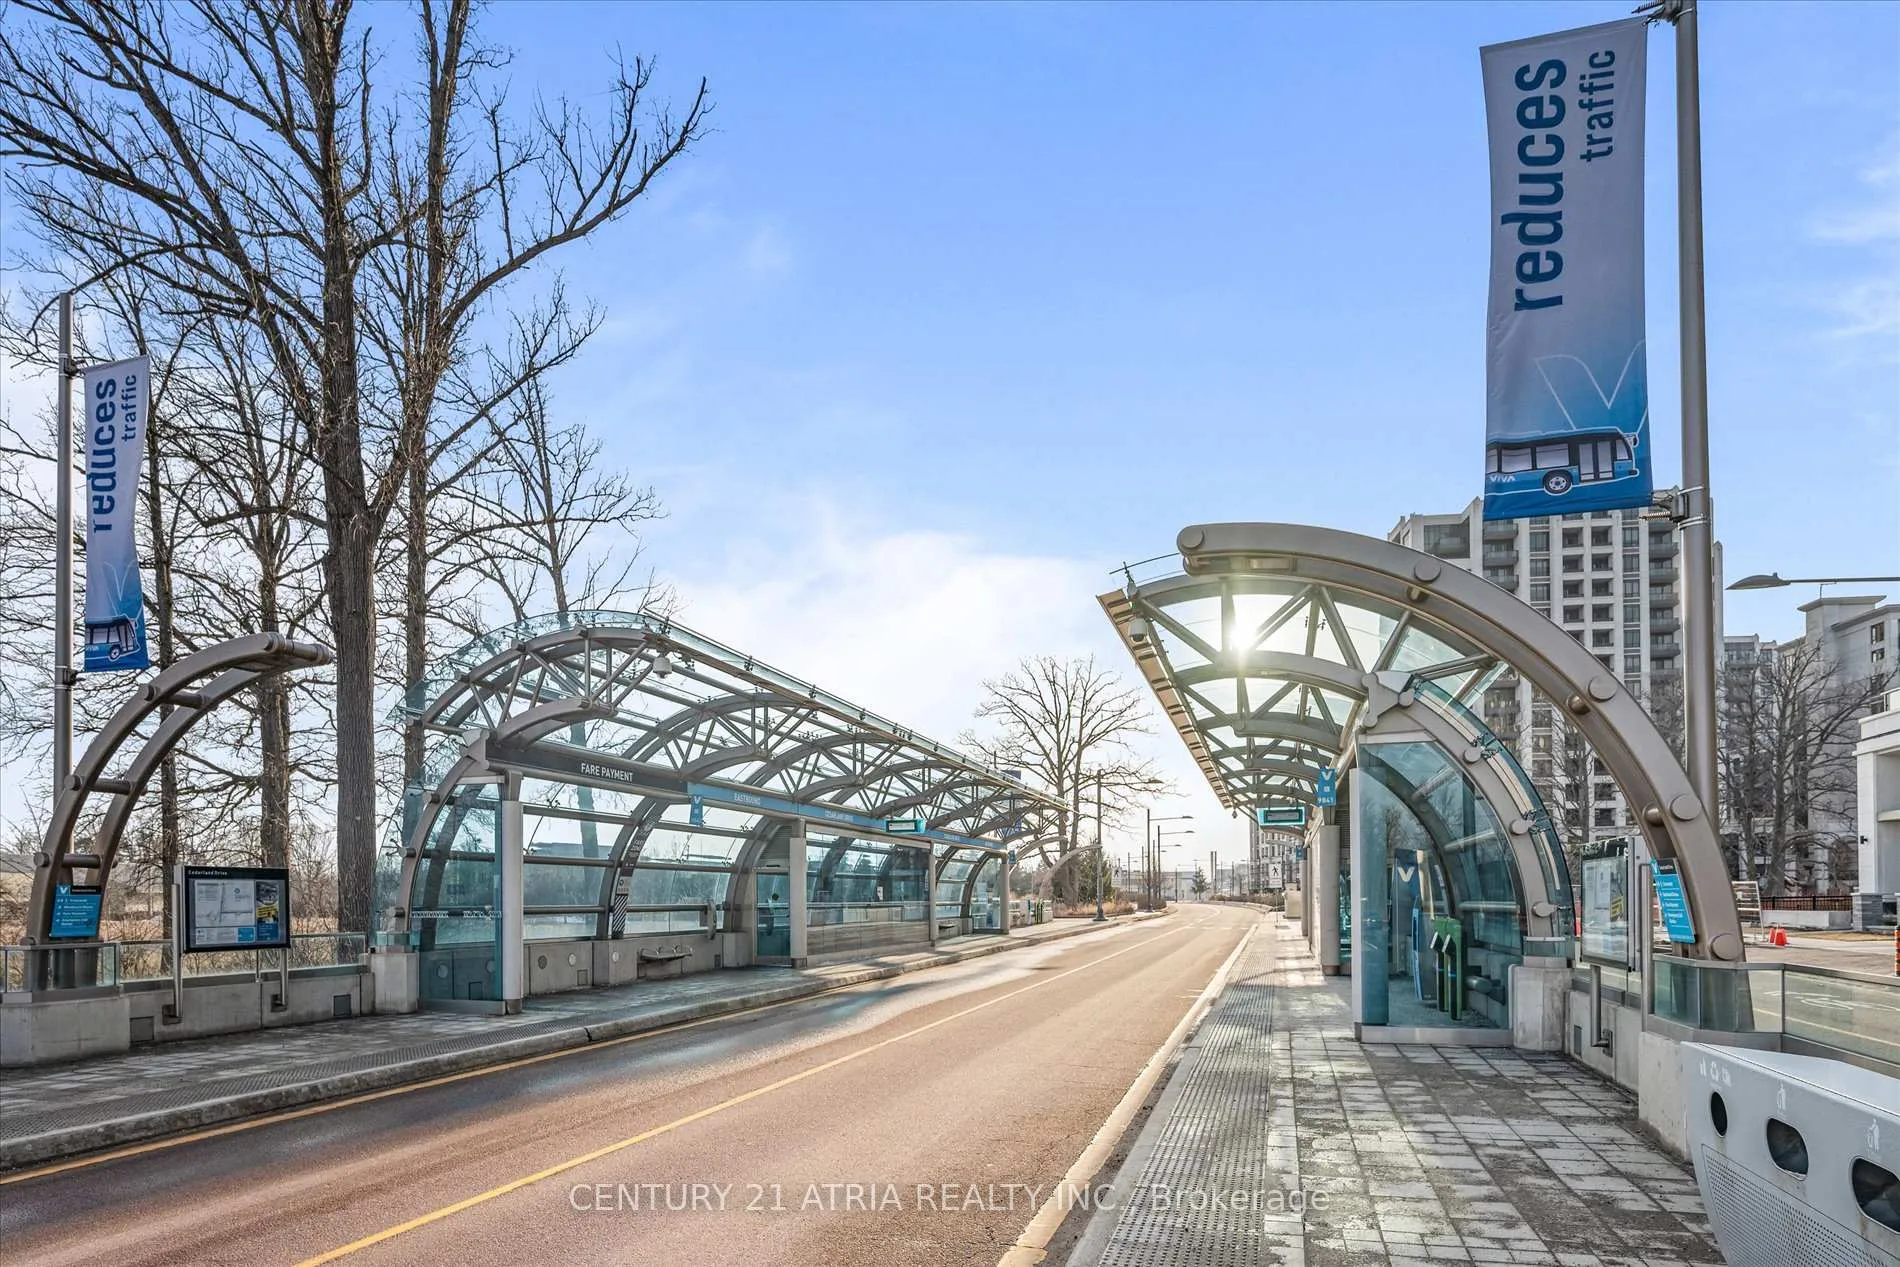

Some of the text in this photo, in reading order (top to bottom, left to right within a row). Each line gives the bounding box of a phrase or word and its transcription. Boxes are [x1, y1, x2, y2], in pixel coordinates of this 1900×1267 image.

[1578, 50, 1616, 162] traffic
[1501, 59, 1567, 312] reduces
[121, 374, 137, 442] traffic
[87, 378, 116, 534] reduces
[1490, 474, 1516, 482] VIVA
[581, 763, 634, 782] FARE PAYMENT
